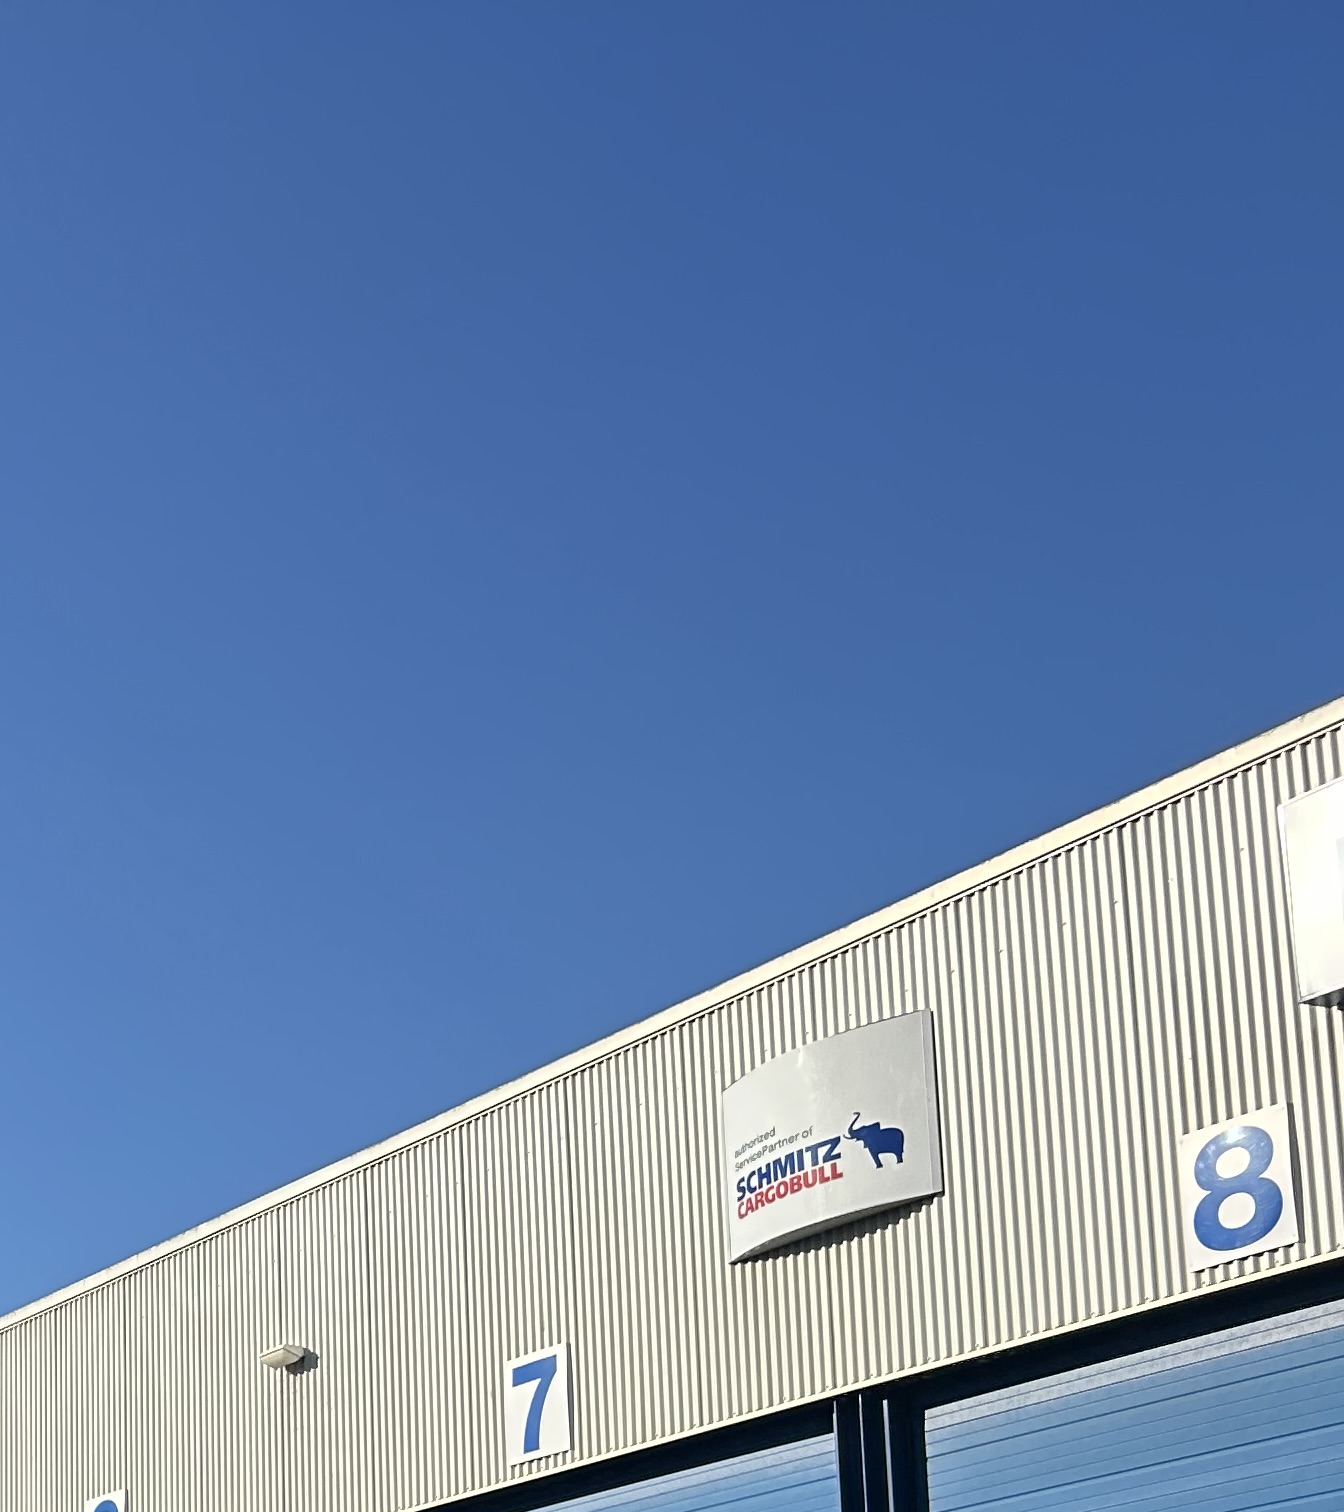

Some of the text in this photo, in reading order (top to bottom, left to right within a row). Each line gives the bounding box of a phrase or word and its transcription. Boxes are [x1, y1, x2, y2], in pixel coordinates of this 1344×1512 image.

[734, 1126, 776, 1159] authorized
[801, 1126, 814, 1139] of
[736, 1135, 842, 1203] SCHMITZ
[737, 1162, 844, 1220] CARGOBULL
[1193, 1124, 1284, 1252] 8
[512, 1353, 558, 1455] 7
